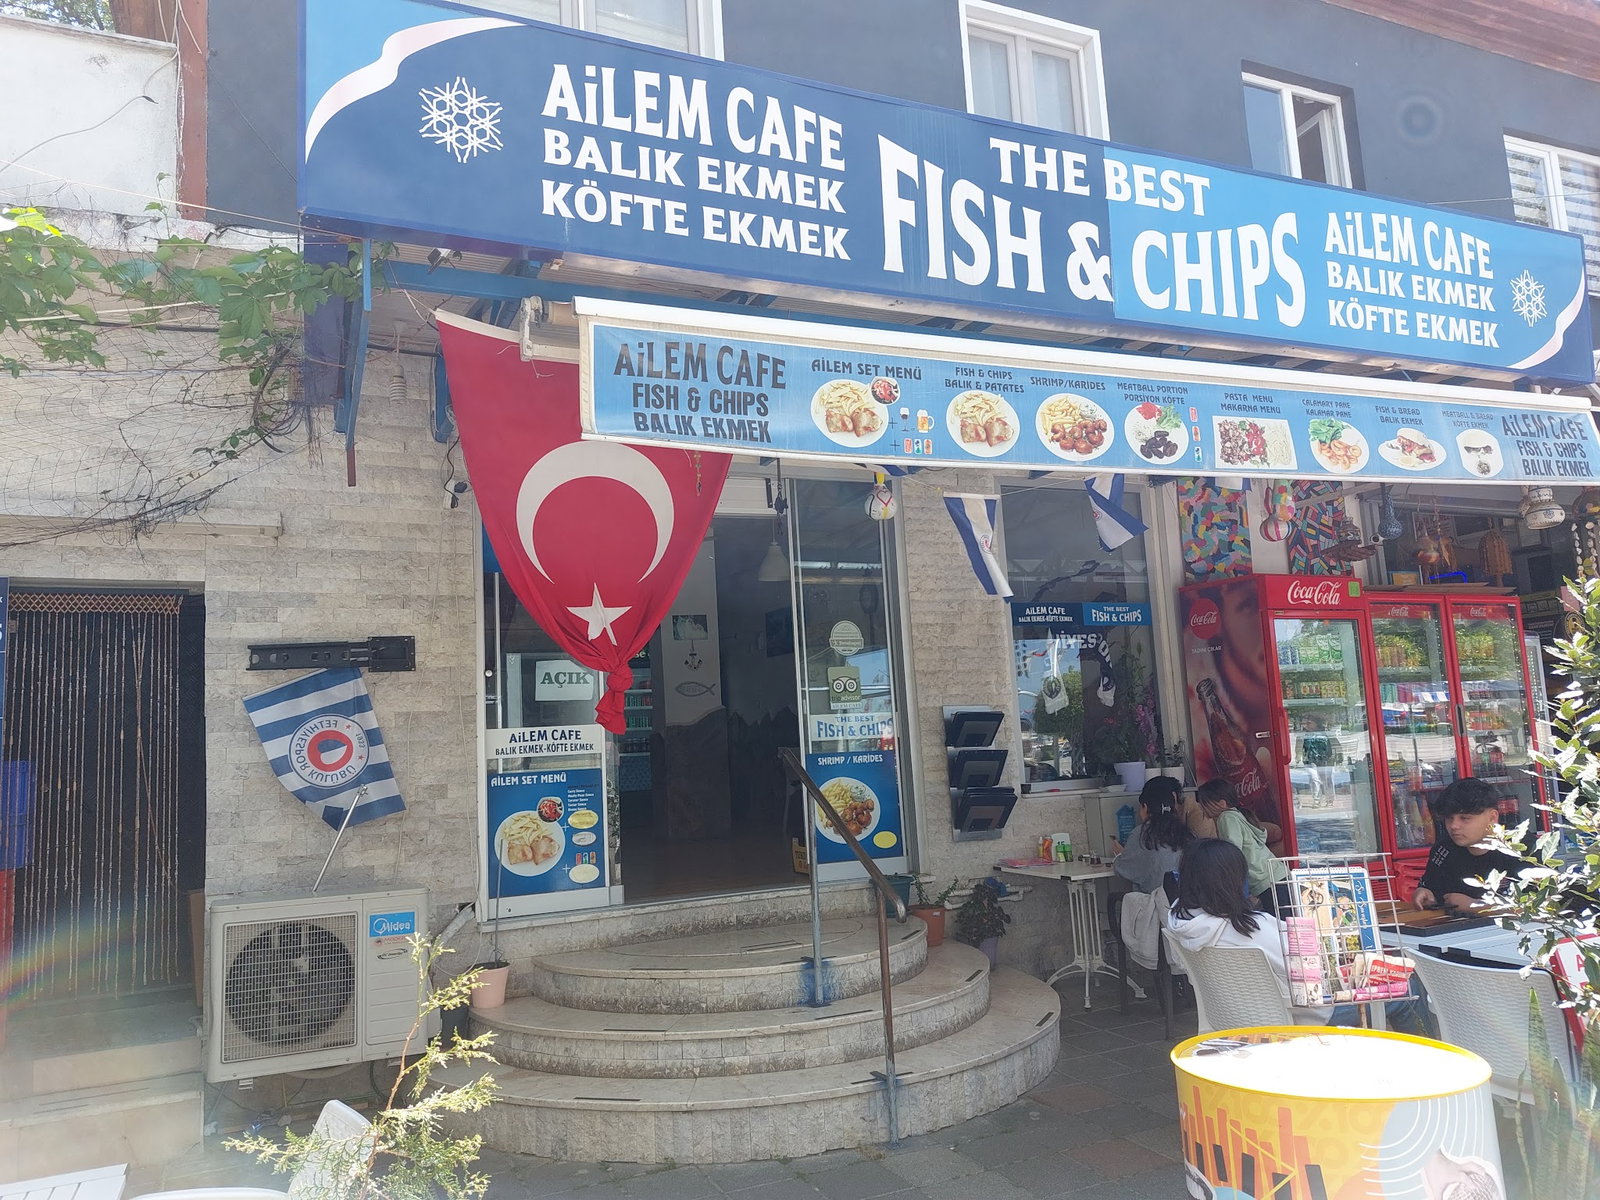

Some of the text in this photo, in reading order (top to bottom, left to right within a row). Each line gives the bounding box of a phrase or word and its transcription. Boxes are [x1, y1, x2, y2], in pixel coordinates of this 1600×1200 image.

[725, 86, 847, 172] CAFE
[543, 129, 847, 214] BALIK EKMEK
[989, 137, 1210, 216] THE BEST
[541, 180, 852, 261] KÖFTE EKMEK
[877, 134, 1306, 328] FISH & CHIPS
[1423, 221, 1494, 280] CAFE
[1326, 260, 1496, 312] BALIK EKMEK
[1328, 297, 1500, 349] KÖFTE EKMEK
[716, 345, 787, 389] CAFE
[811, 357, 922, 381] AİLEM SET MENÜ
[955, 366, 1013, 380] FISH & CHIPS
[944, 378, 1025, 394] BALIK & PATATES
[1030, 376, 1106, 391] SHRIMP/KARİDES
[1117, 382, 1188, 395] MEATBALL PORTION
[632, 382, 769, 417] FISH & CHIPS
[1224, 392, 1249, 402] PASTA
[1220, 403, 1258, 413] MAKARNA
[1375, 405, 1390, 414] FISH
[1398, 407, 1420, 416] BREAD
[633, 411, 772, 443] BALIK EKMEK
[1380, 415, 1424, 426] BALIK EKMEK
[1549, 416, 1588, 441] CAFE
[1517, 440, 1586, 459] FISH & CHIPS
[1523, 459, 1594, 478] BALIK EKMEK
[1287, 580, 1342, 605] Coca-Cola
[1048, 606, 1066, 615] CAFE
[1091, 609, 1142, 622] FISH & CHIPS
[1190, 611, 1217, 627] Coca-Cola
[540, 671, 591, 688] AÇIK
[551, 729, 582, 741] CAFE
[817, 718, 893, 738] FISH & CHIPS
[495, 745, 517, 756] BALIK
[570, 743, 594, 752] EKMEK
[817, 756, 845, 766] SHRIMP
[853, 753, 883, 763] KARİDES
[490, 771, 567, 788] AİLEM SET MENÜ
[373, 917, 411, 936] Midea
